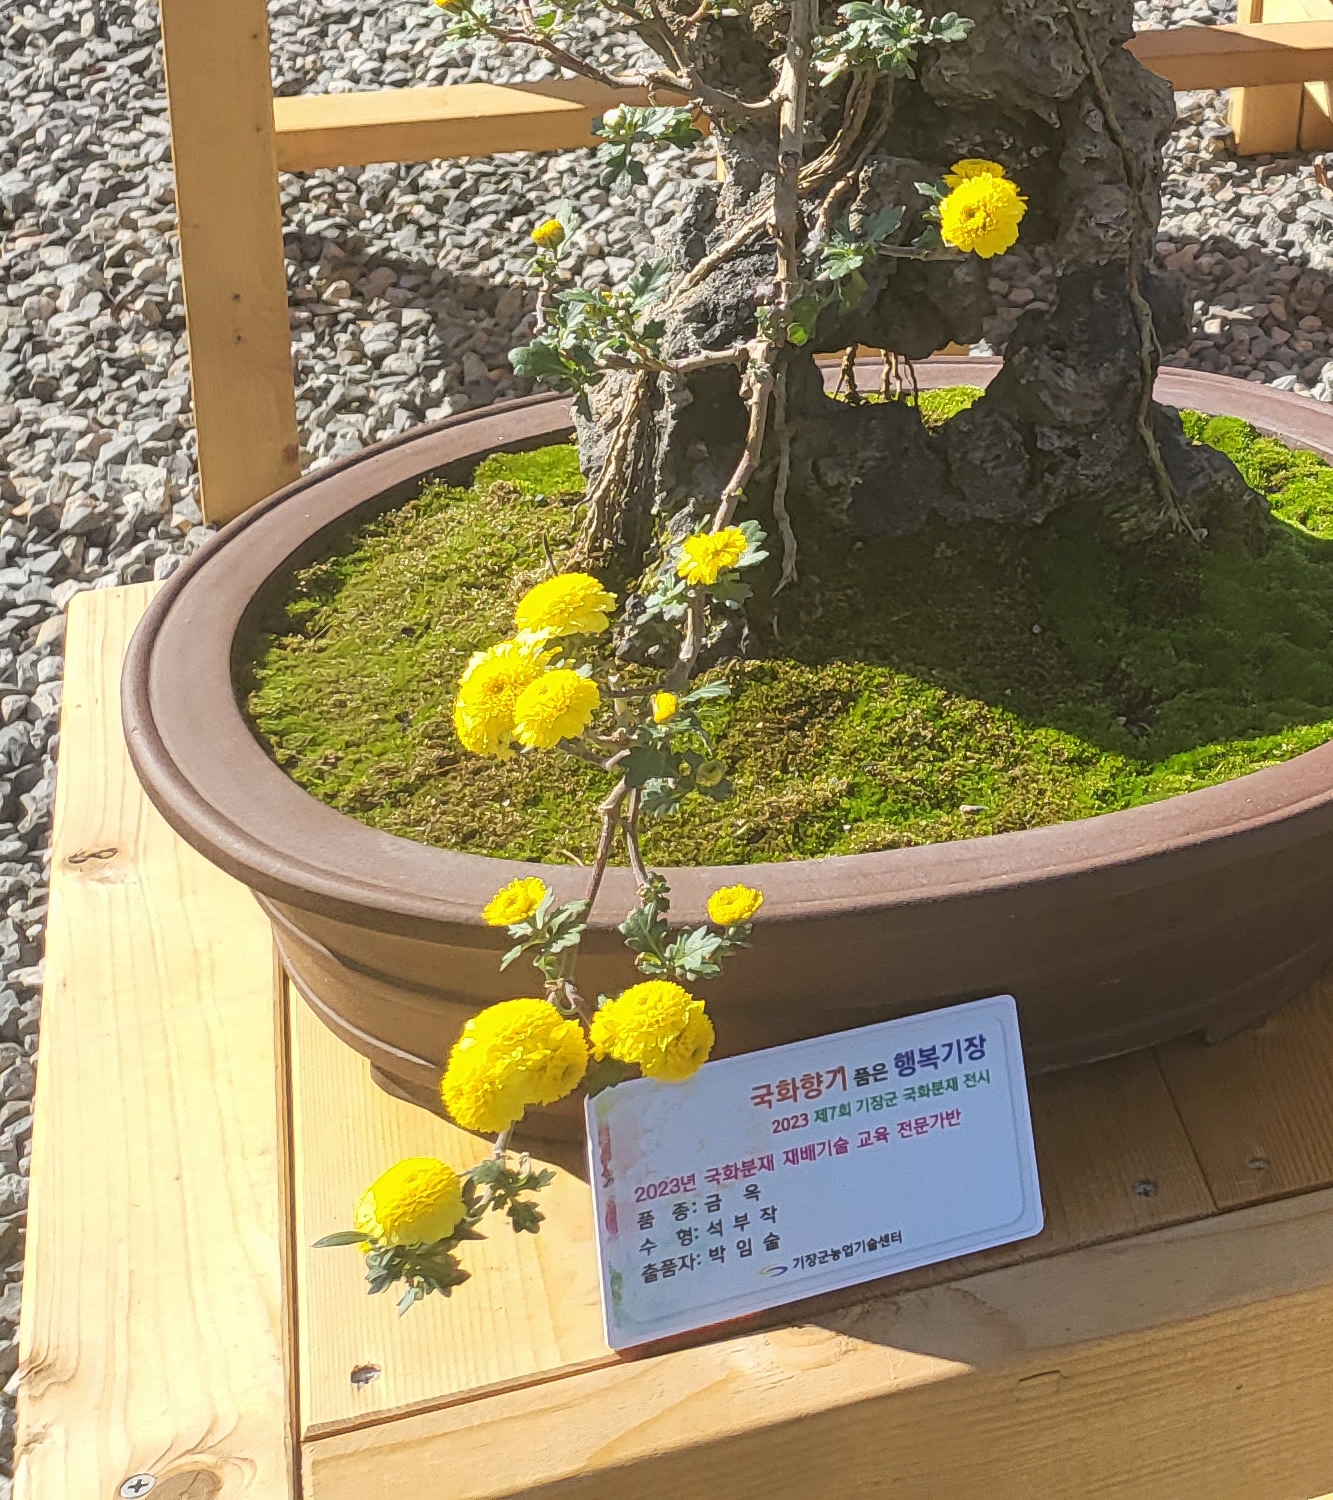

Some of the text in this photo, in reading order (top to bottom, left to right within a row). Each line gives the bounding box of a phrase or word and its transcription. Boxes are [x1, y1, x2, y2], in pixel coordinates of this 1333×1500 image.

[750, 1033, 987, 1111] 국화향기 품은 행복기장
[771, 1068, 991, 1134] 2023 제7회 기장군 국화분재 전시
[634, 1107, 962, 1203] 2023년 국화분재 재배기술 교육 전문가반
[641, 1251, 702, 1285] 출품자:
[791, 1229, 903, 1270] 기장군농업기술센터
